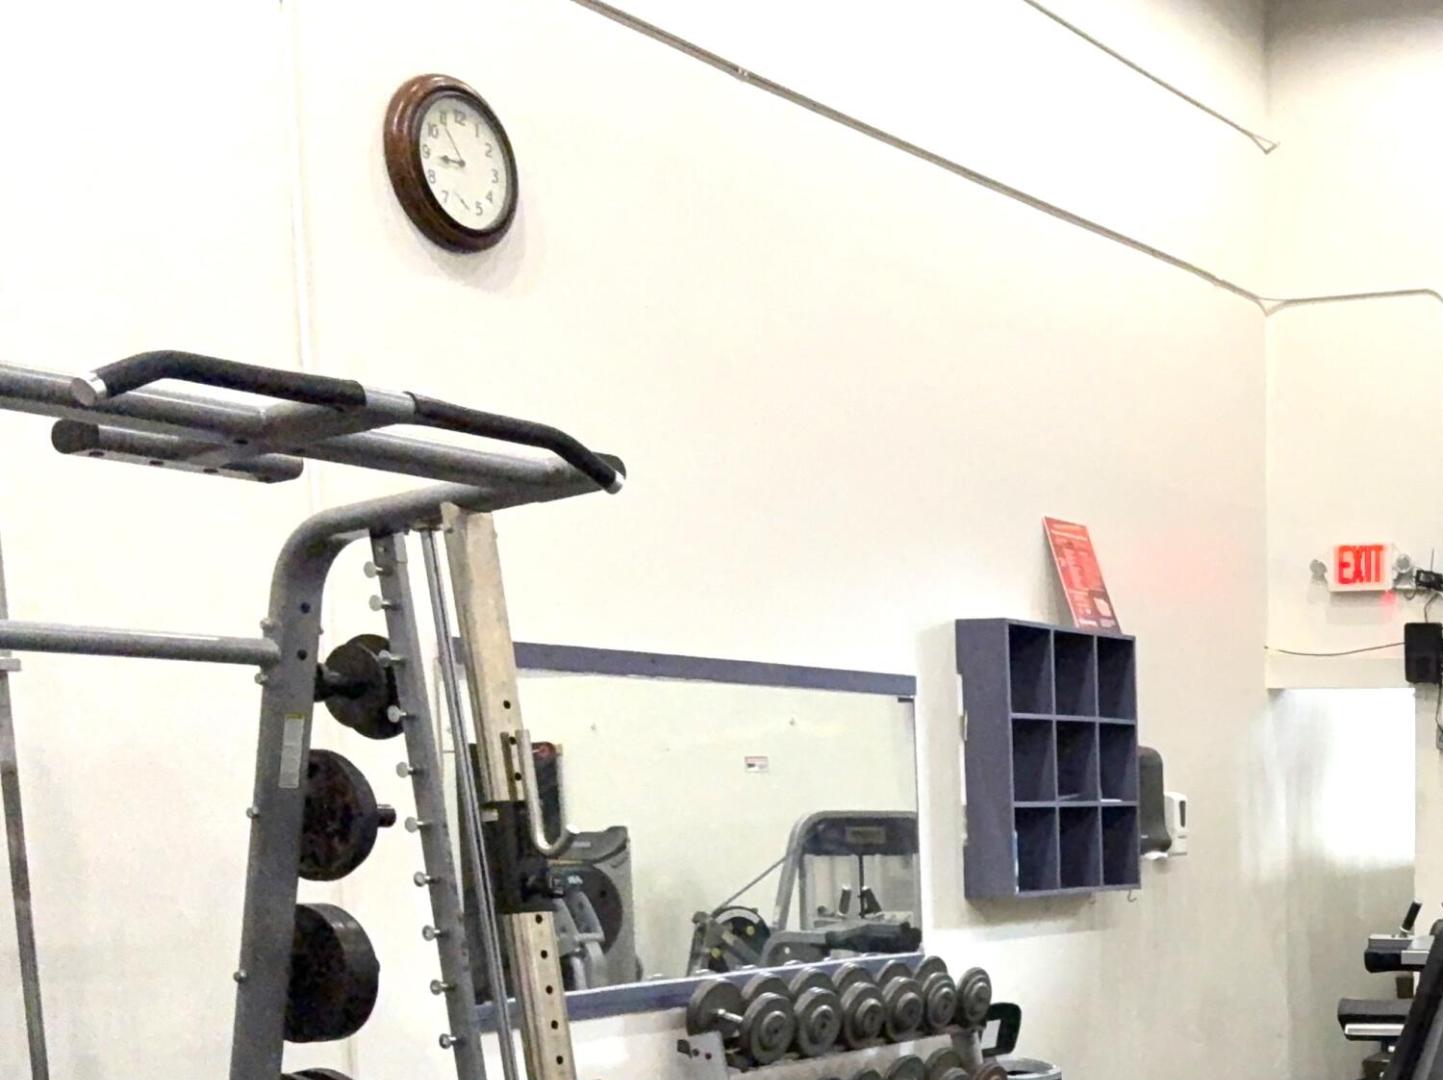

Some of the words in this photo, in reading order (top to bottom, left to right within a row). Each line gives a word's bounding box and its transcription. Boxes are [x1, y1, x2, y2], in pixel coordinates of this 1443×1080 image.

[421, 143, 431, 159] 9
[484, 142, 492, 158] 2
[428, 169, 436, 184] 8
[491, 168, 499, 183] 3
[441, 190, 449, 203] 7
[475, 201, 484, 216] 5
[1338, 545, 1383, 584] EXIT
